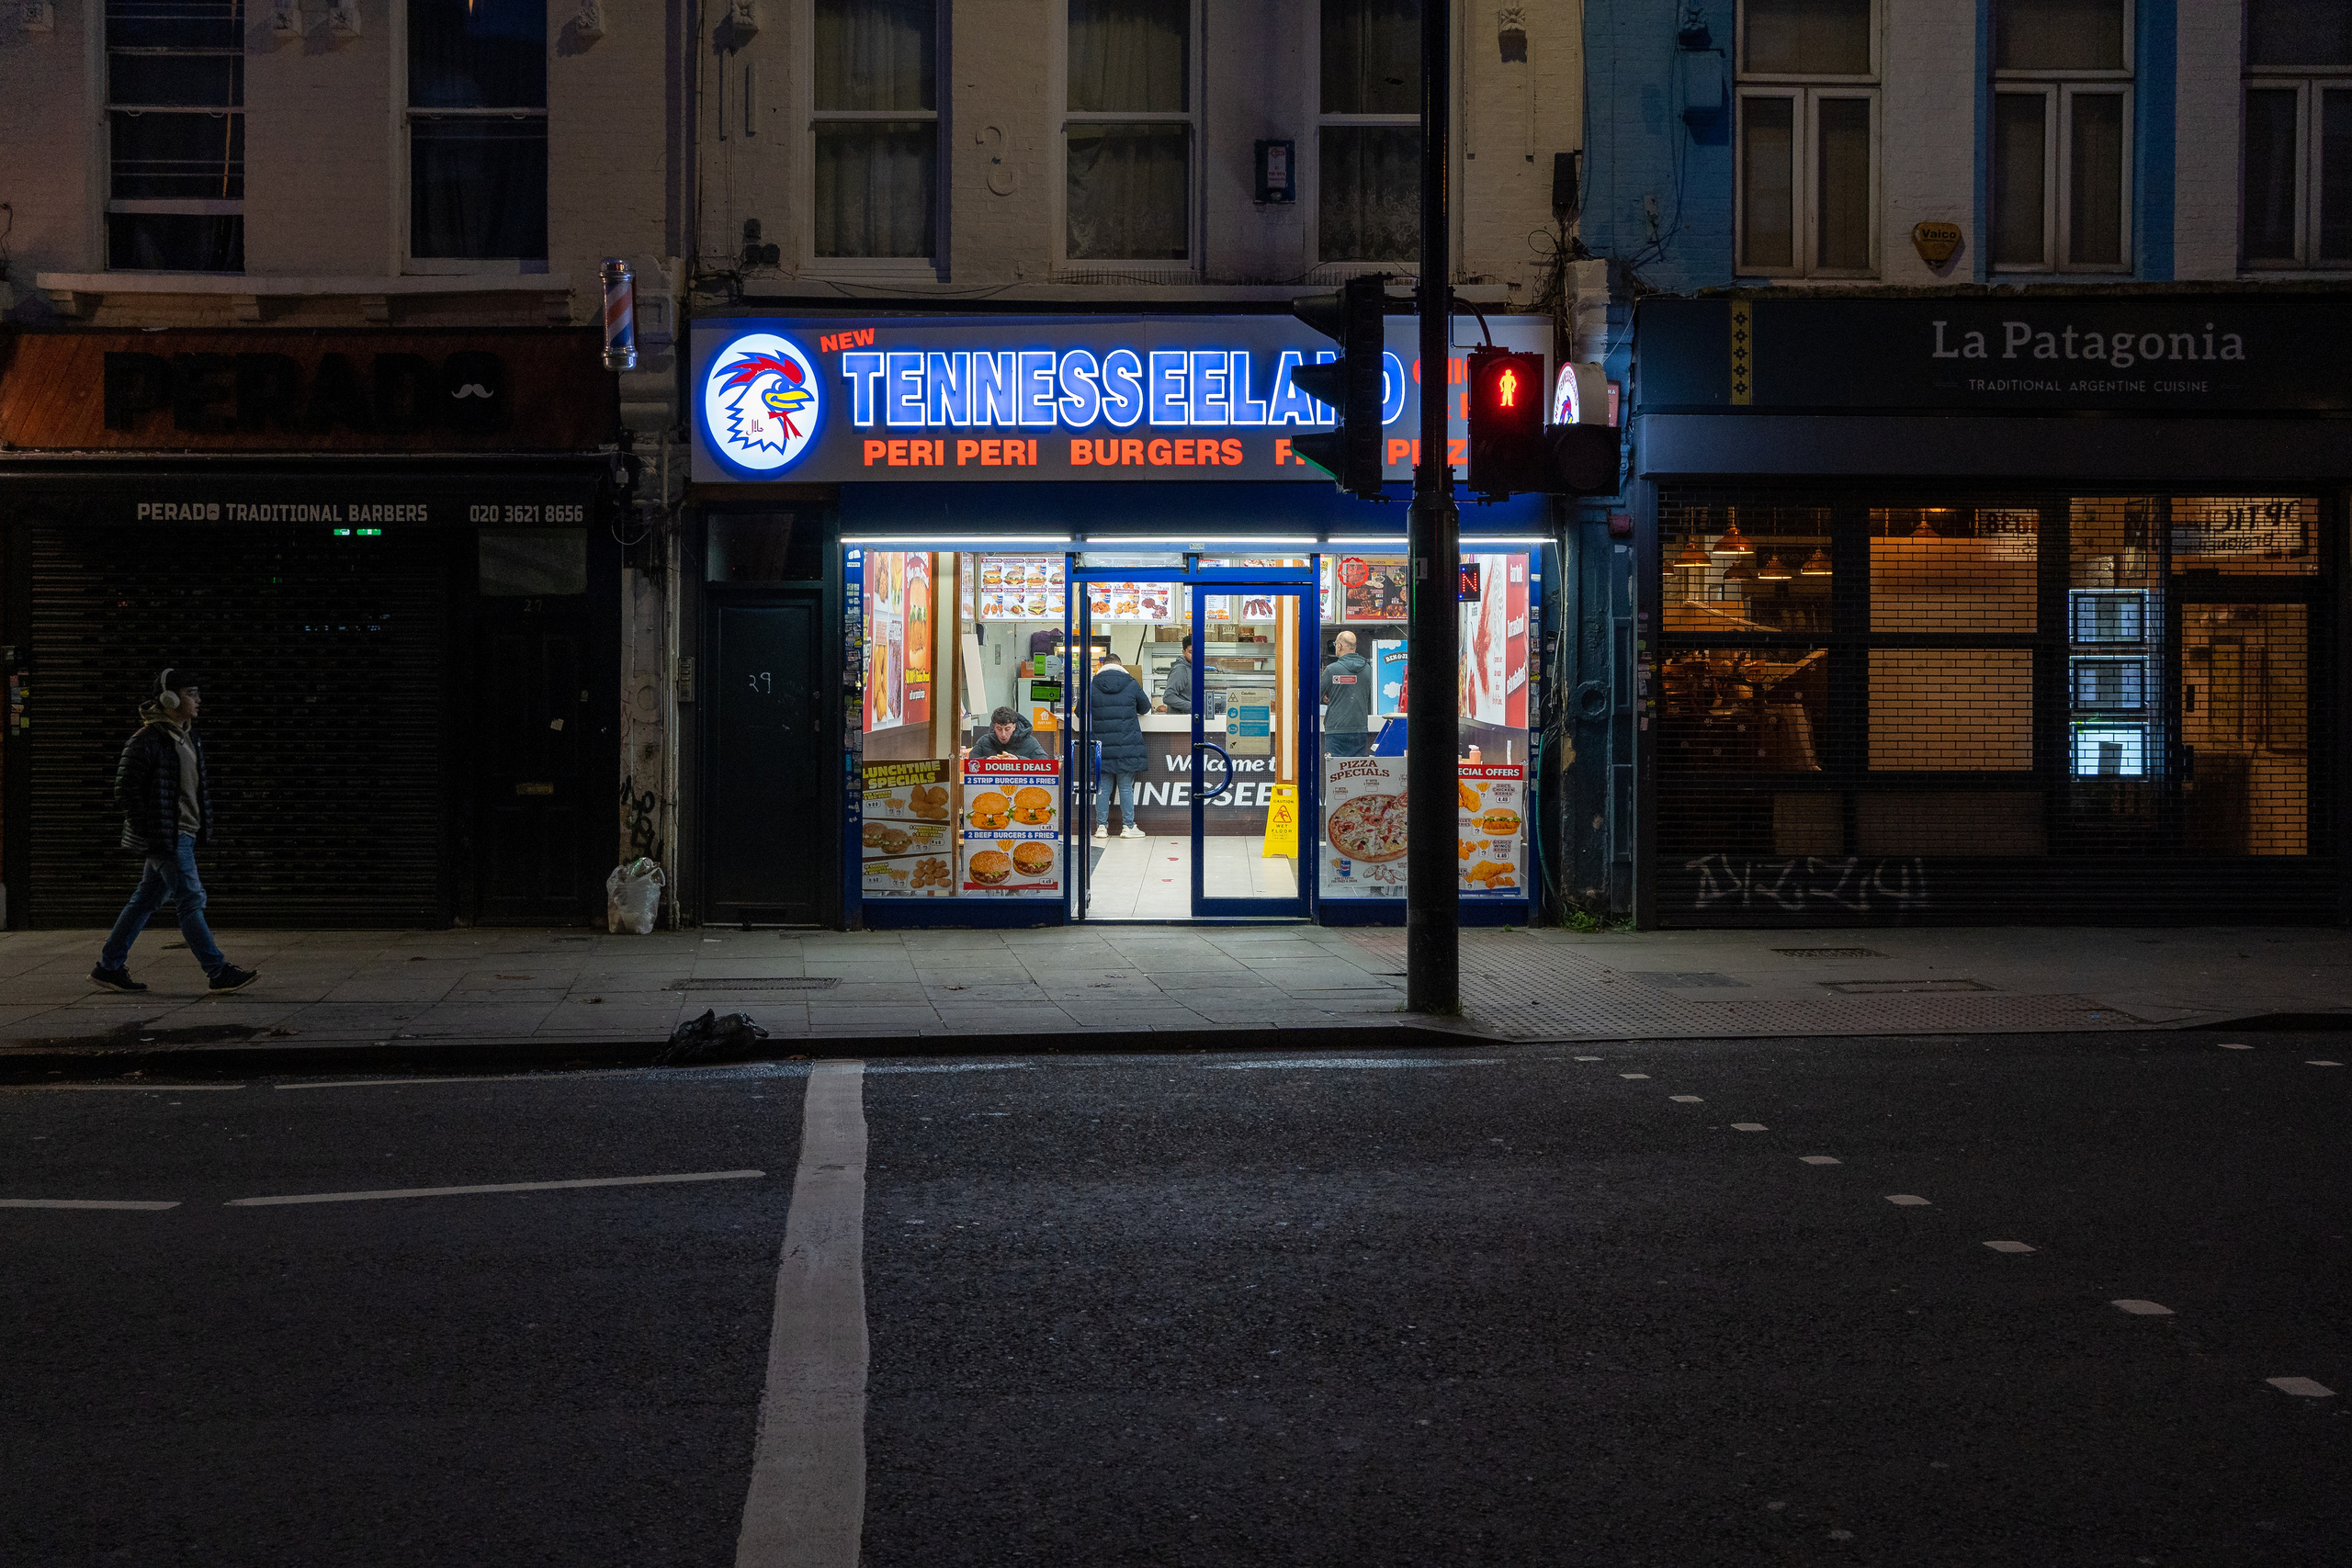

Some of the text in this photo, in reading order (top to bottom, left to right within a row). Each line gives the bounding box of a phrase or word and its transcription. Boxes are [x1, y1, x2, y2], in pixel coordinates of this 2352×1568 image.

[1922, 229, 1956, 239] Vaico
[820, 328, 876, 353] NEW
[1932, 321, 2245, 368] La Patagonia
[842, 350, 1406, 427] TENNESSEELAD
[1969, 379, 2209, 392] TRADITIONAL ARGENTINE CUISINE
[864, 439, 944, 466] PERI
[956, 439, 1037, 466] PERI
[1070, 438, 1243, 466] BURGERS
[137, 503, 428, 522] PERADO TRADITIONAL BARBERS
[469, 505, 583, 523] 020 3621 8656
[749, 671, 771, 694] 29
[863, 761, 941, 779] LUNCHTIME
[985, 762, 1052, 772] DOUBLE DEALS
[1340, 760, 1377, 770] PIZZA
[868, 773, 936, 789] SPECIALS
[1329, 768, 1390, 783] SPECIALS
